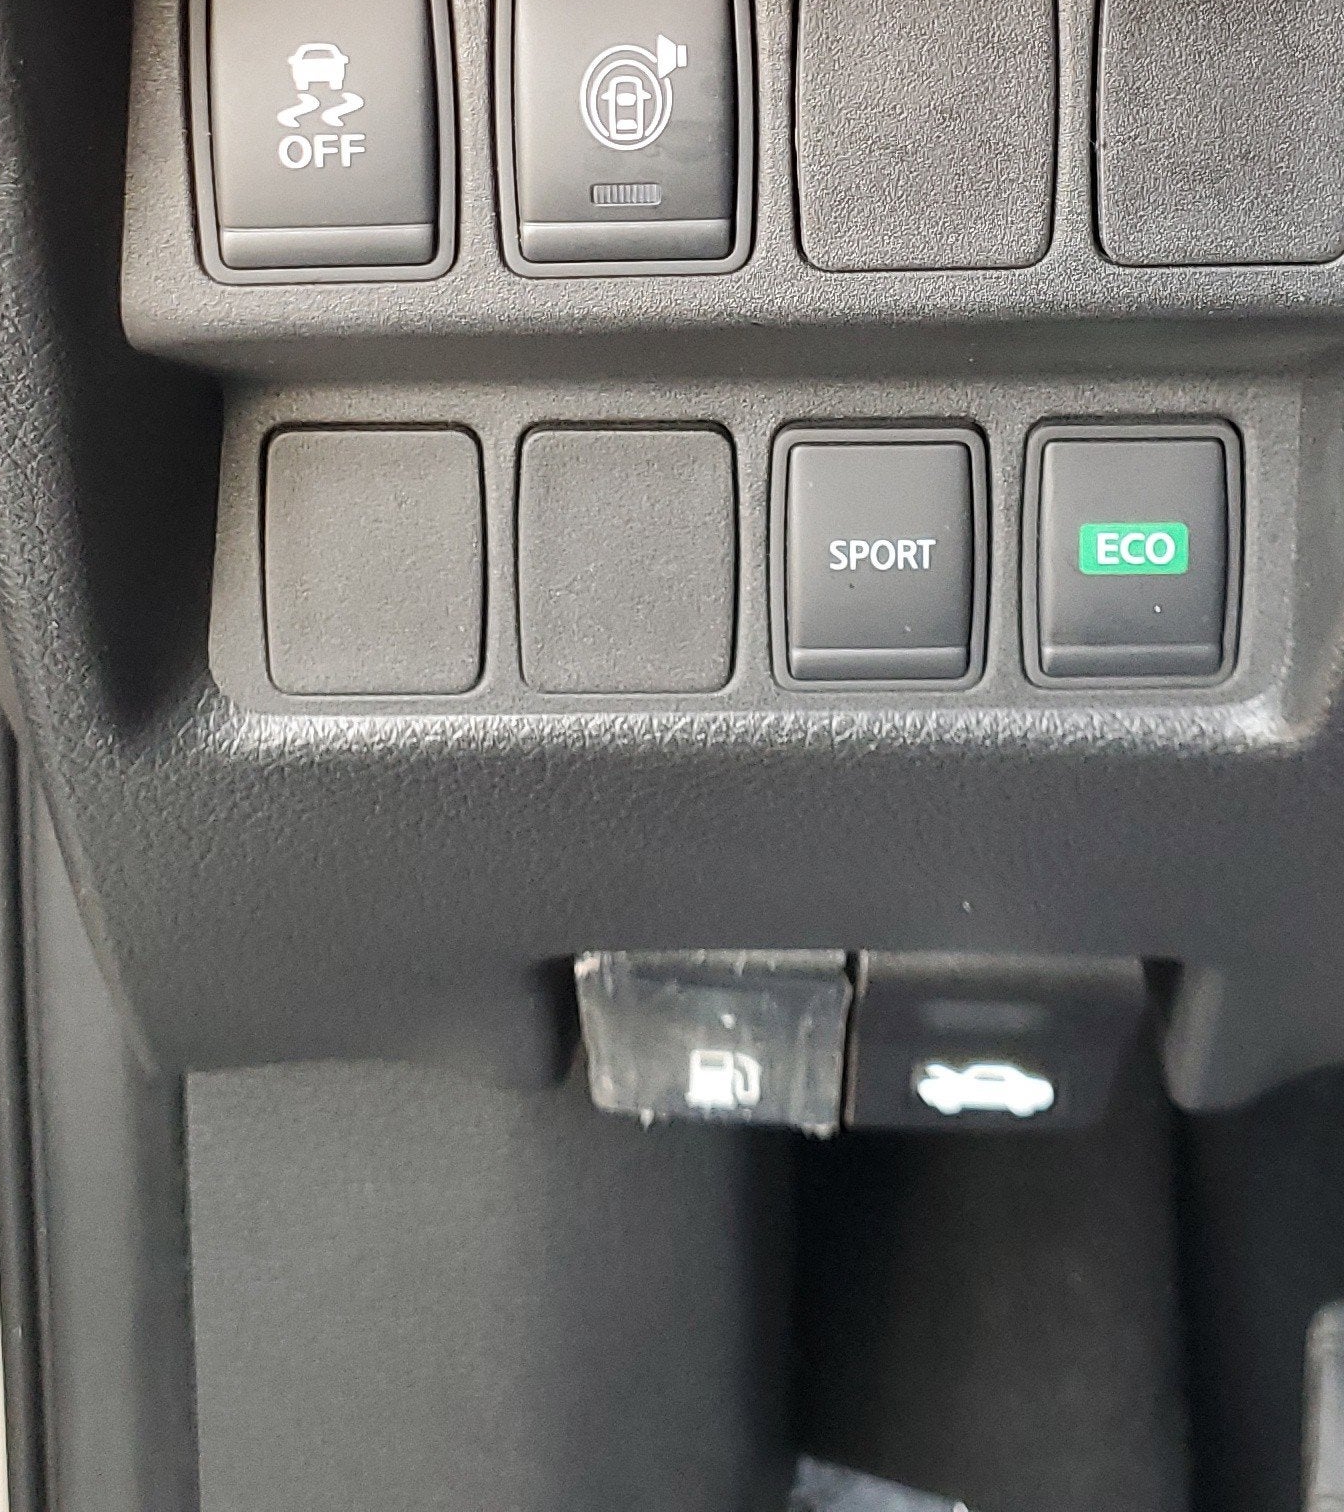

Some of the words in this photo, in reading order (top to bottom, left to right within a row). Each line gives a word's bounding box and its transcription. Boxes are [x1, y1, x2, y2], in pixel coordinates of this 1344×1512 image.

[278, 133, 366, 169] OFF
[829, 538, 937, 571] SPORT
[1096, 531, 1176, 565] ECO
